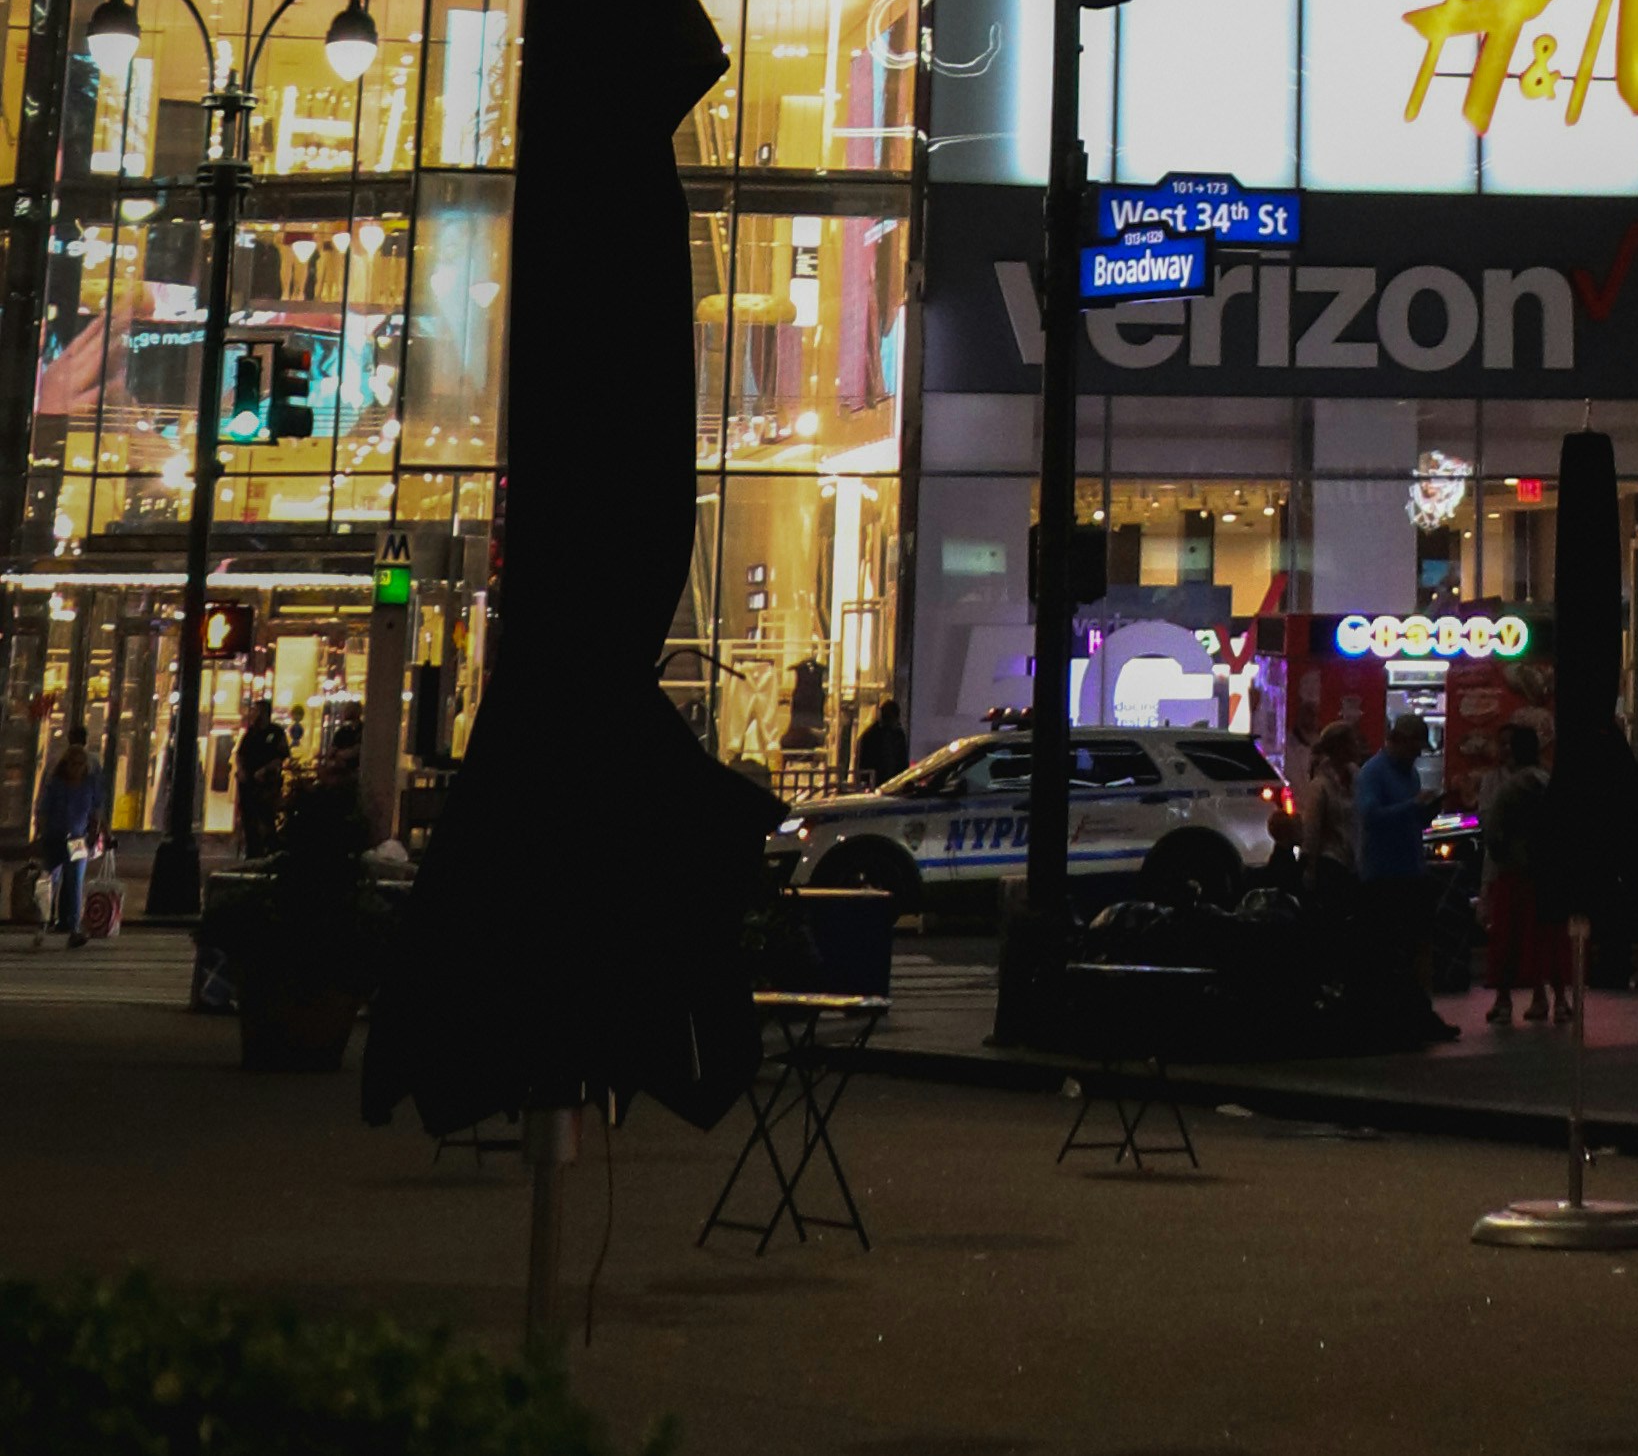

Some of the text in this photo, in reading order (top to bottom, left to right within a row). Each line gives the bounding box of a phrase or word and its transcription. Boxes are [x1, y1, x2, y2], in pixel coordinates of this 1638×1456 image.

[1172, 181, 1230, 196] 101 173
[1111, 199, 1289, 235] West 34th St
[1093, 249, 1194, 289] Broadway
